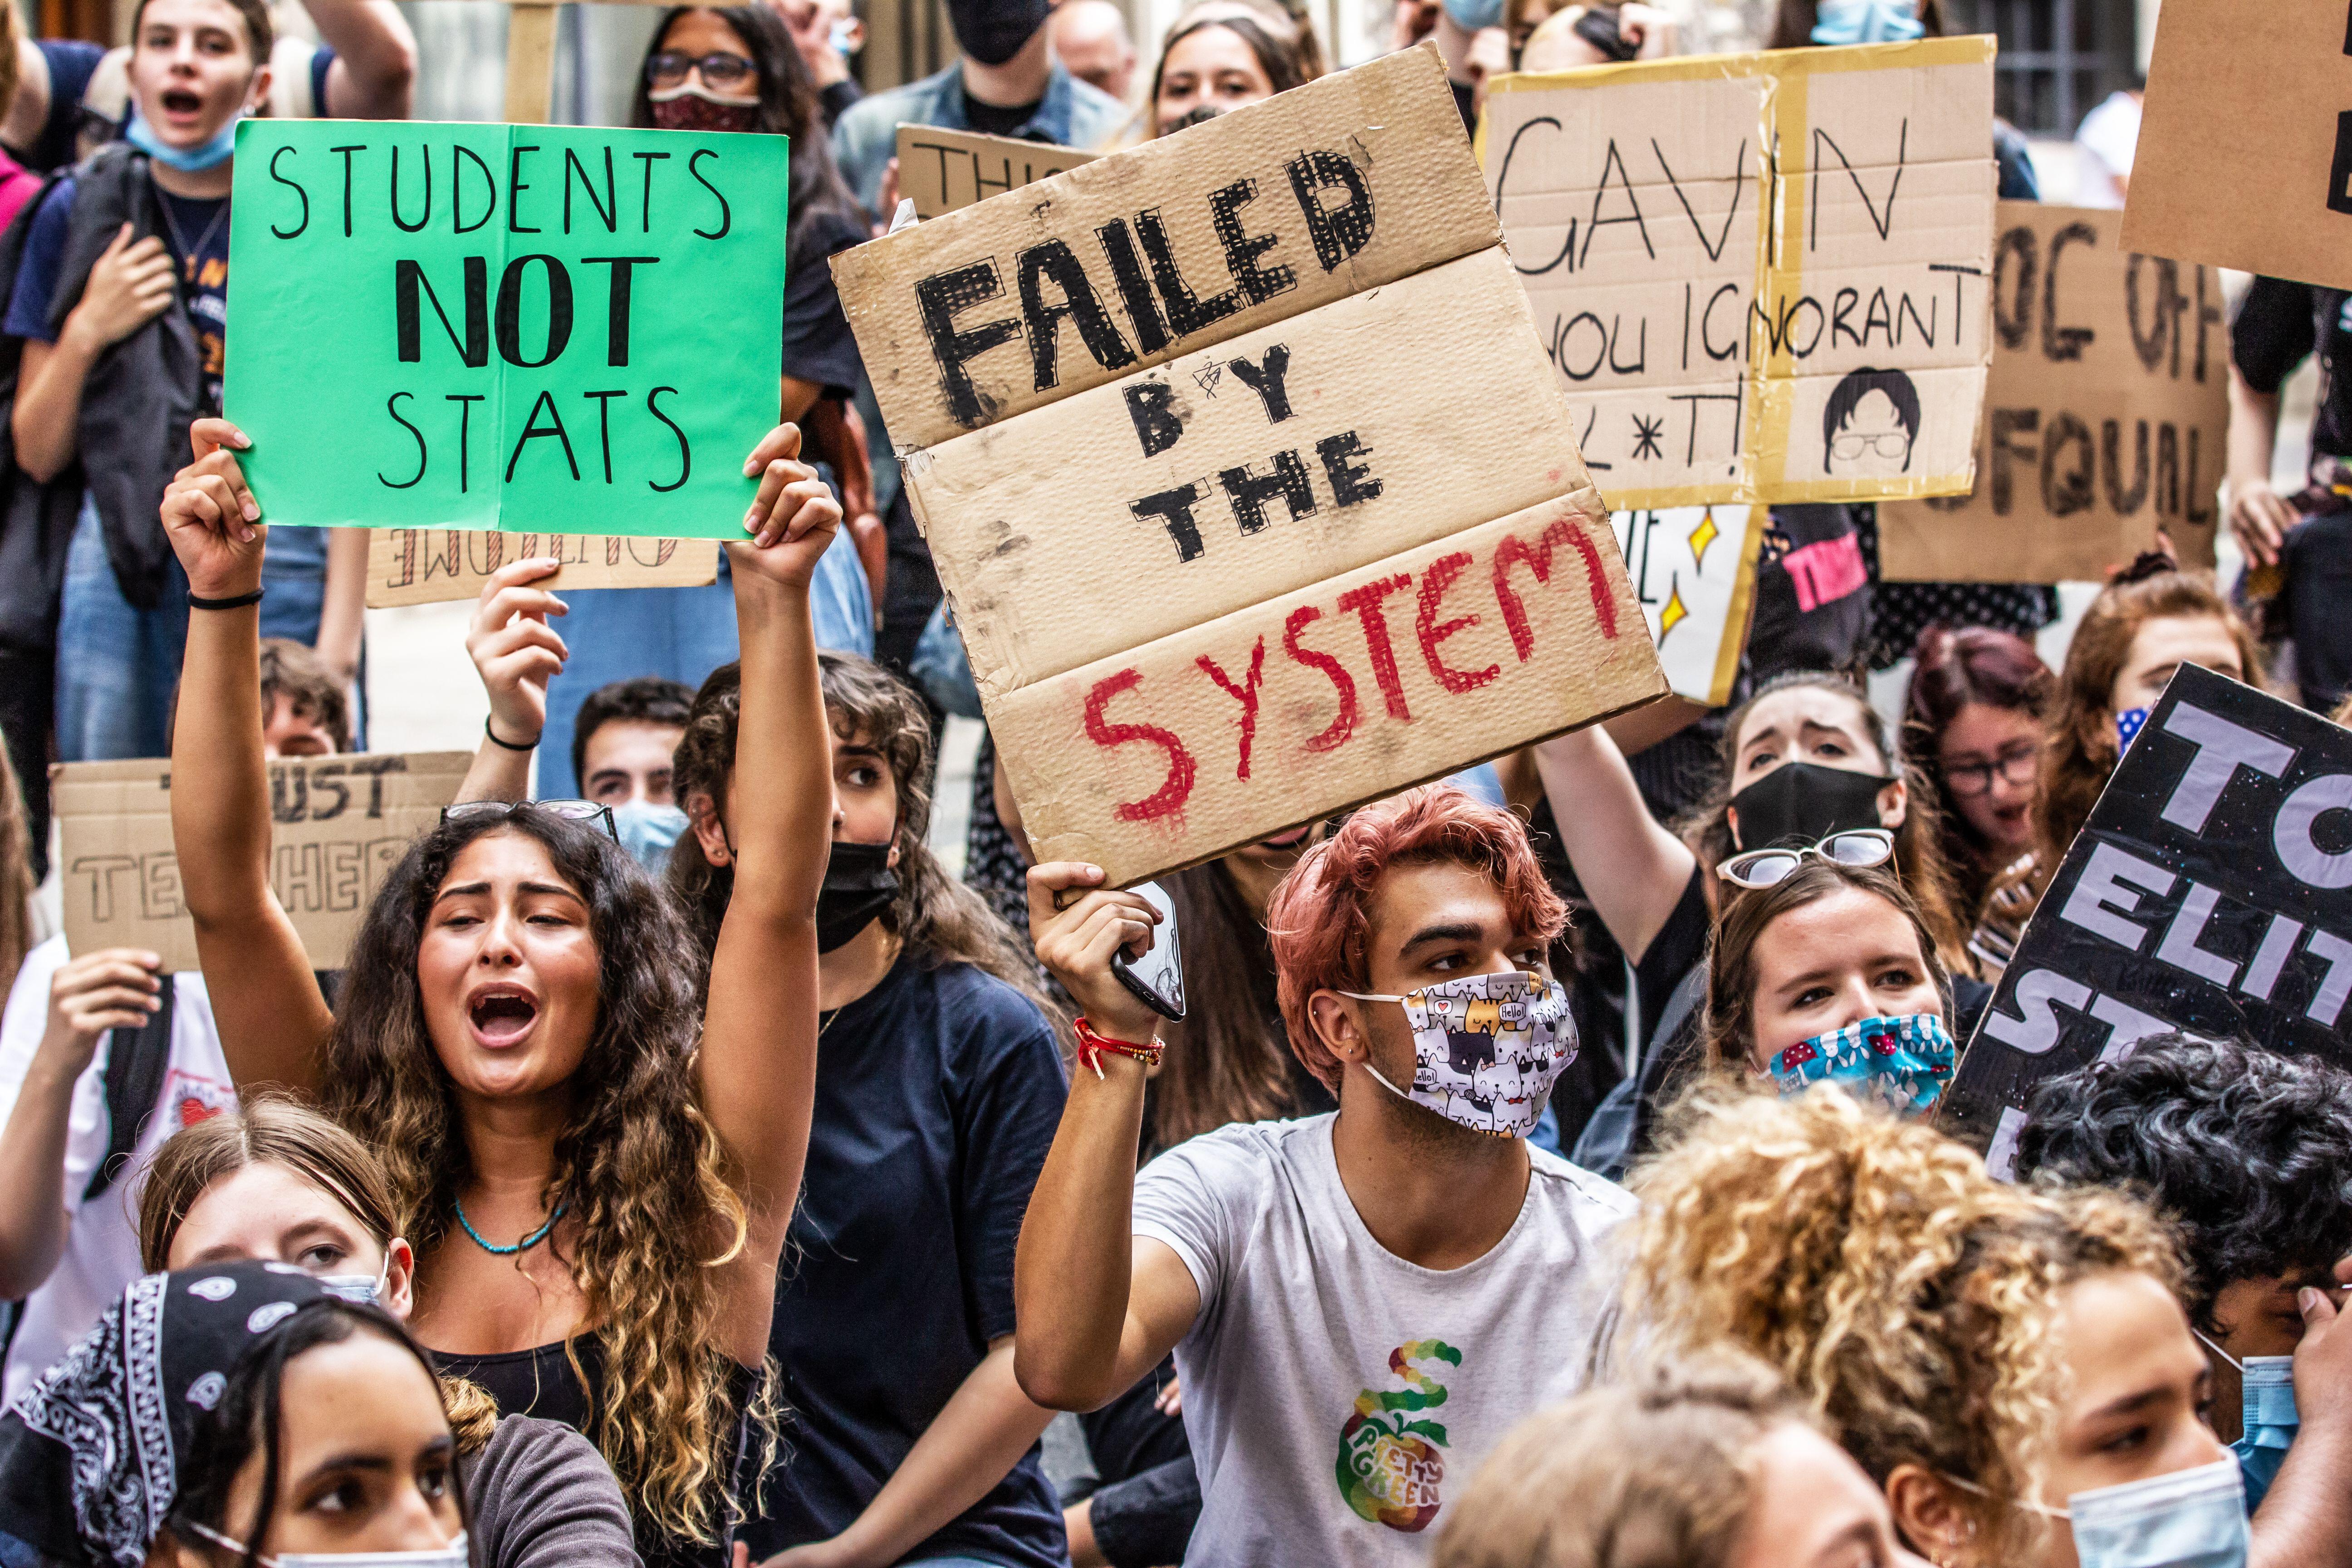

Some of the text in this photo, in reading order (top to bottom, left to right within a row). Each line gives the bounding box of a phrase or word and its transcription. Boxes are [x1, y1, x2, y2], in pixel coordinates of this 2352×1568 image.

[270, 143, 730, 240] STUDENTS
[912, 142, 1064, 202] THI
[1494, 117, 1907, 274] GAVIN
[396, 254, 660, 368] NOT
[915, 150, 1375, 428] FAILED
[1681, 262, 1982, 370] IGNORANT
[377, 386, 691, 493] STATS
[1122, 343, 1297, 459] BY
[1127, 431, 1384, 563] THE
[1923, 405, 2210, 524] FQUAL
[1083, 520, 1619, 822] SYSTEM
[1502, 1004, 1525, 1019] Hello!
[1983, 968, 2214, 1066] ST
[1353, 1427, 1443, 1485] PRETTY
[1353, 1450, 1440, 1504] GREEN
